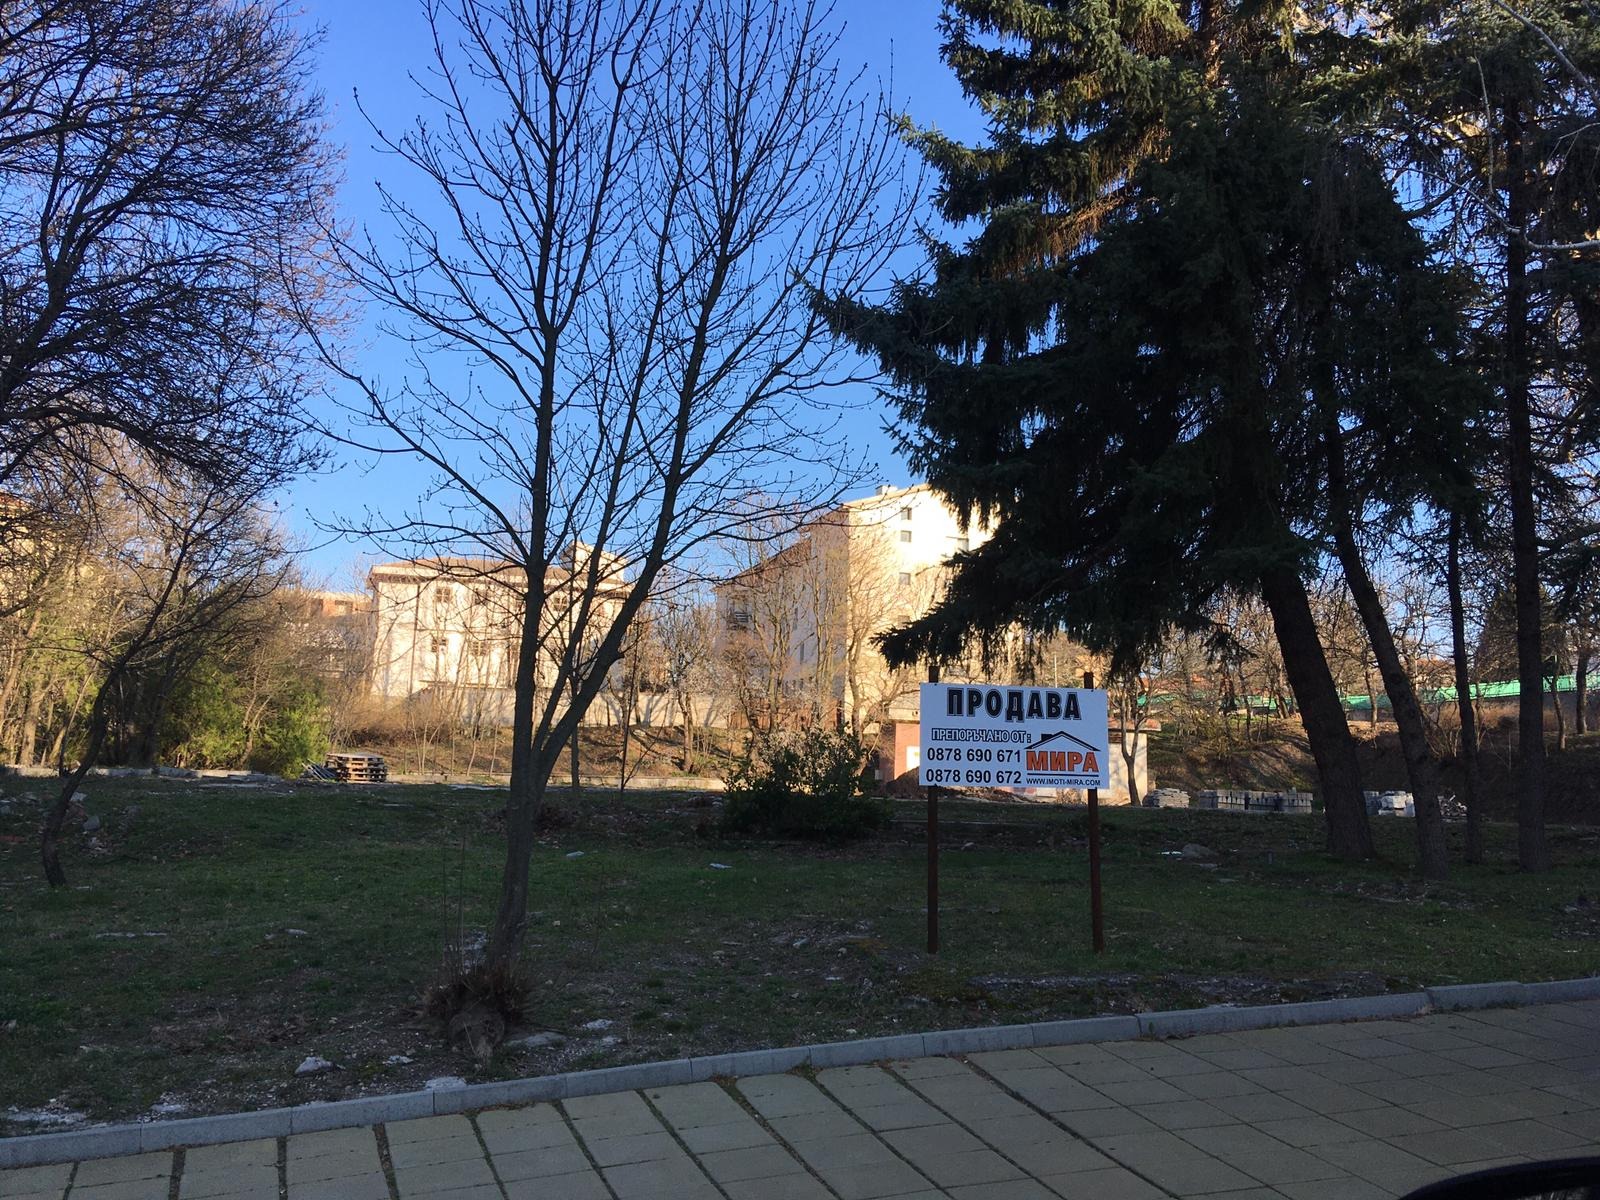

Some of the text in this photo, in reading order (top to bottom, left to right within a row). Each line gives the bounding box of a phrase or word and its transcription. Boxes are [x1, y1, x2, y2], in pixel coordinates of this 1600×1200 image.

[947, 687, 1082, 723] ПРОДАВА
[931, 728, 1010, 742] ПРЕПОРЪЧАНО
[927, 747, 1021, 763] 0878 690 671
[1026, 750, 1099, 772] МИРА
[926, 768, 1022, 784] 0878 690 672
[1026, 777, 1101, 786] WWW.IMOTI-MIRA.COM
